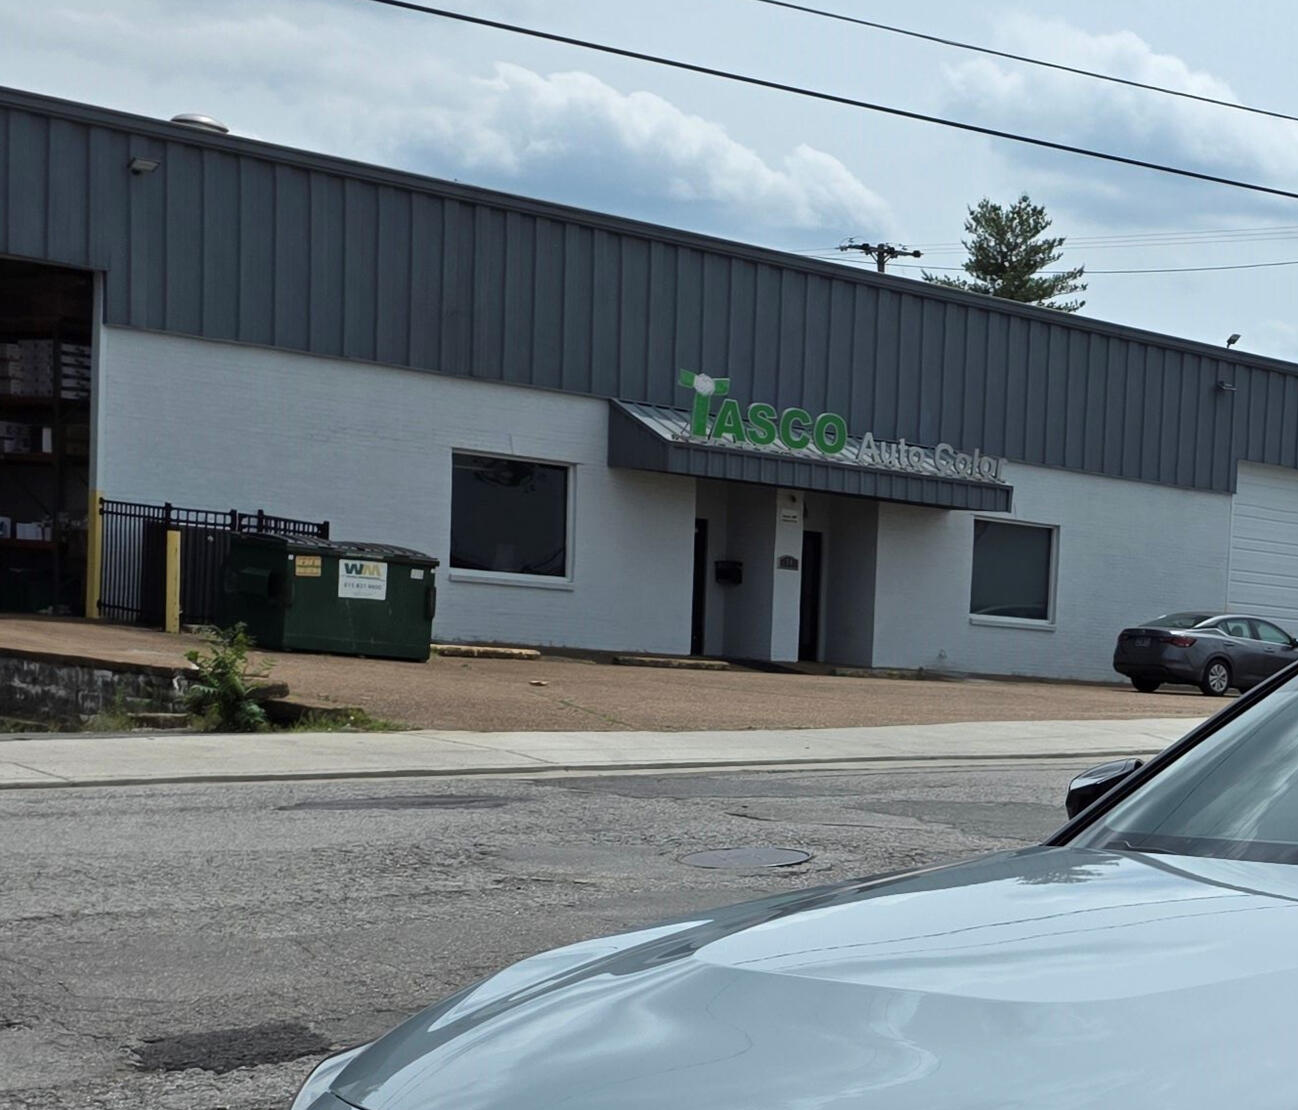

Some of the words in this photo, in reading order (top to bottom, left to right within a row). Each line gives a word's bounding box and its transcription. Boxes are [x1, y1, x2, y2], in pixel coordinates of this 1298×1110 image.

[678, 369, 849, 455] TASCO
[857, 431, 925, 470] Auto
[934, 442, 1009, 482] Color
[344, 562, 382, 577] WM
